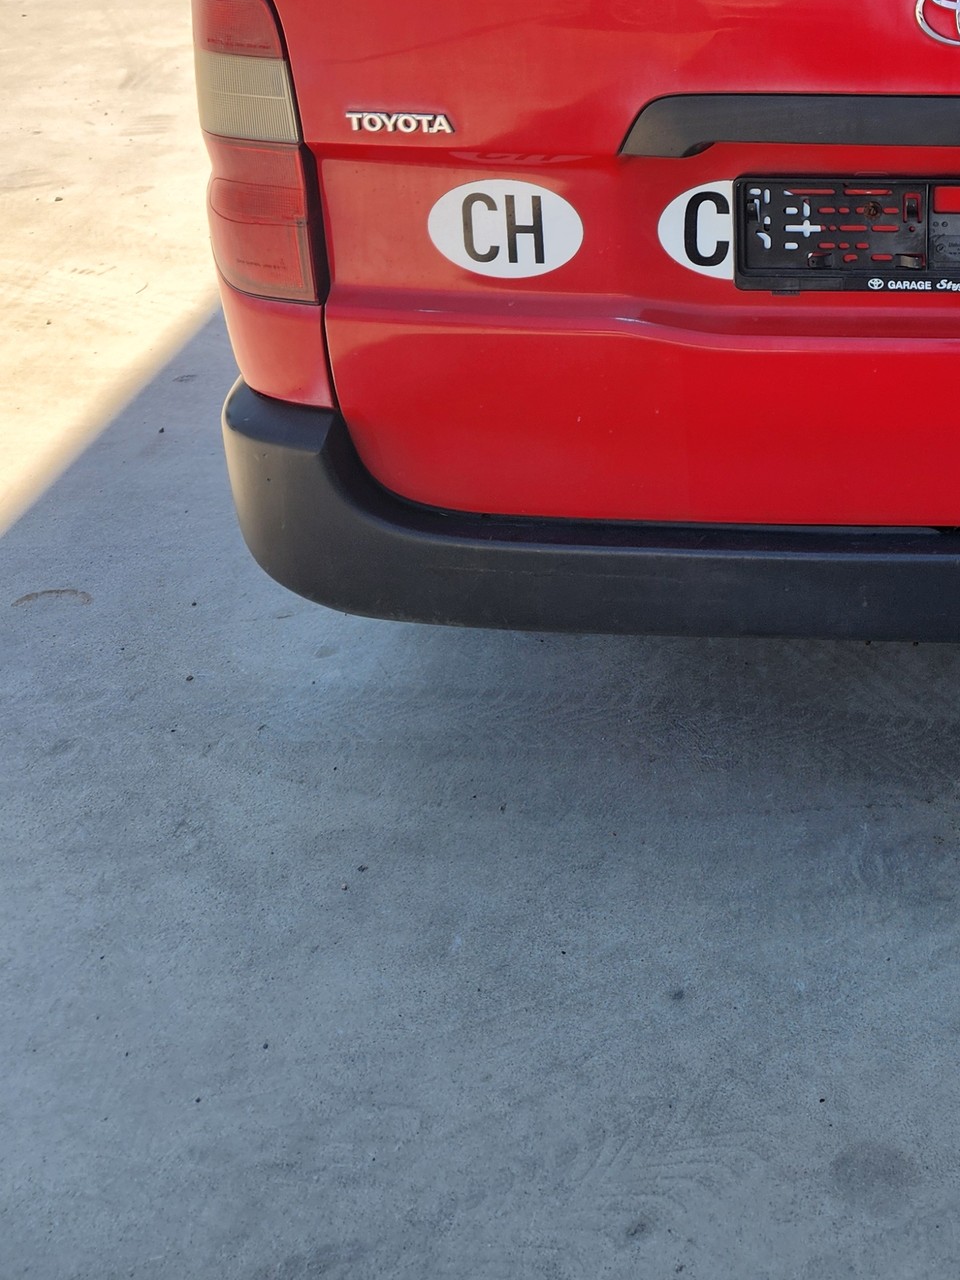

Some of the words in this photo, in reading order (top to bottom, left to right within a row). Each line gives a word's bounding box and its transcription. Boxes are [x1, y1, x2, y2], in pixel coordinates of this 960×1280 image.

[345, 111, 455, 134] TOYOTA
[461, 192, 545, 264] CH
[683, 191, 731, 266] C
[887, 280, 932, 290] GARAGE
